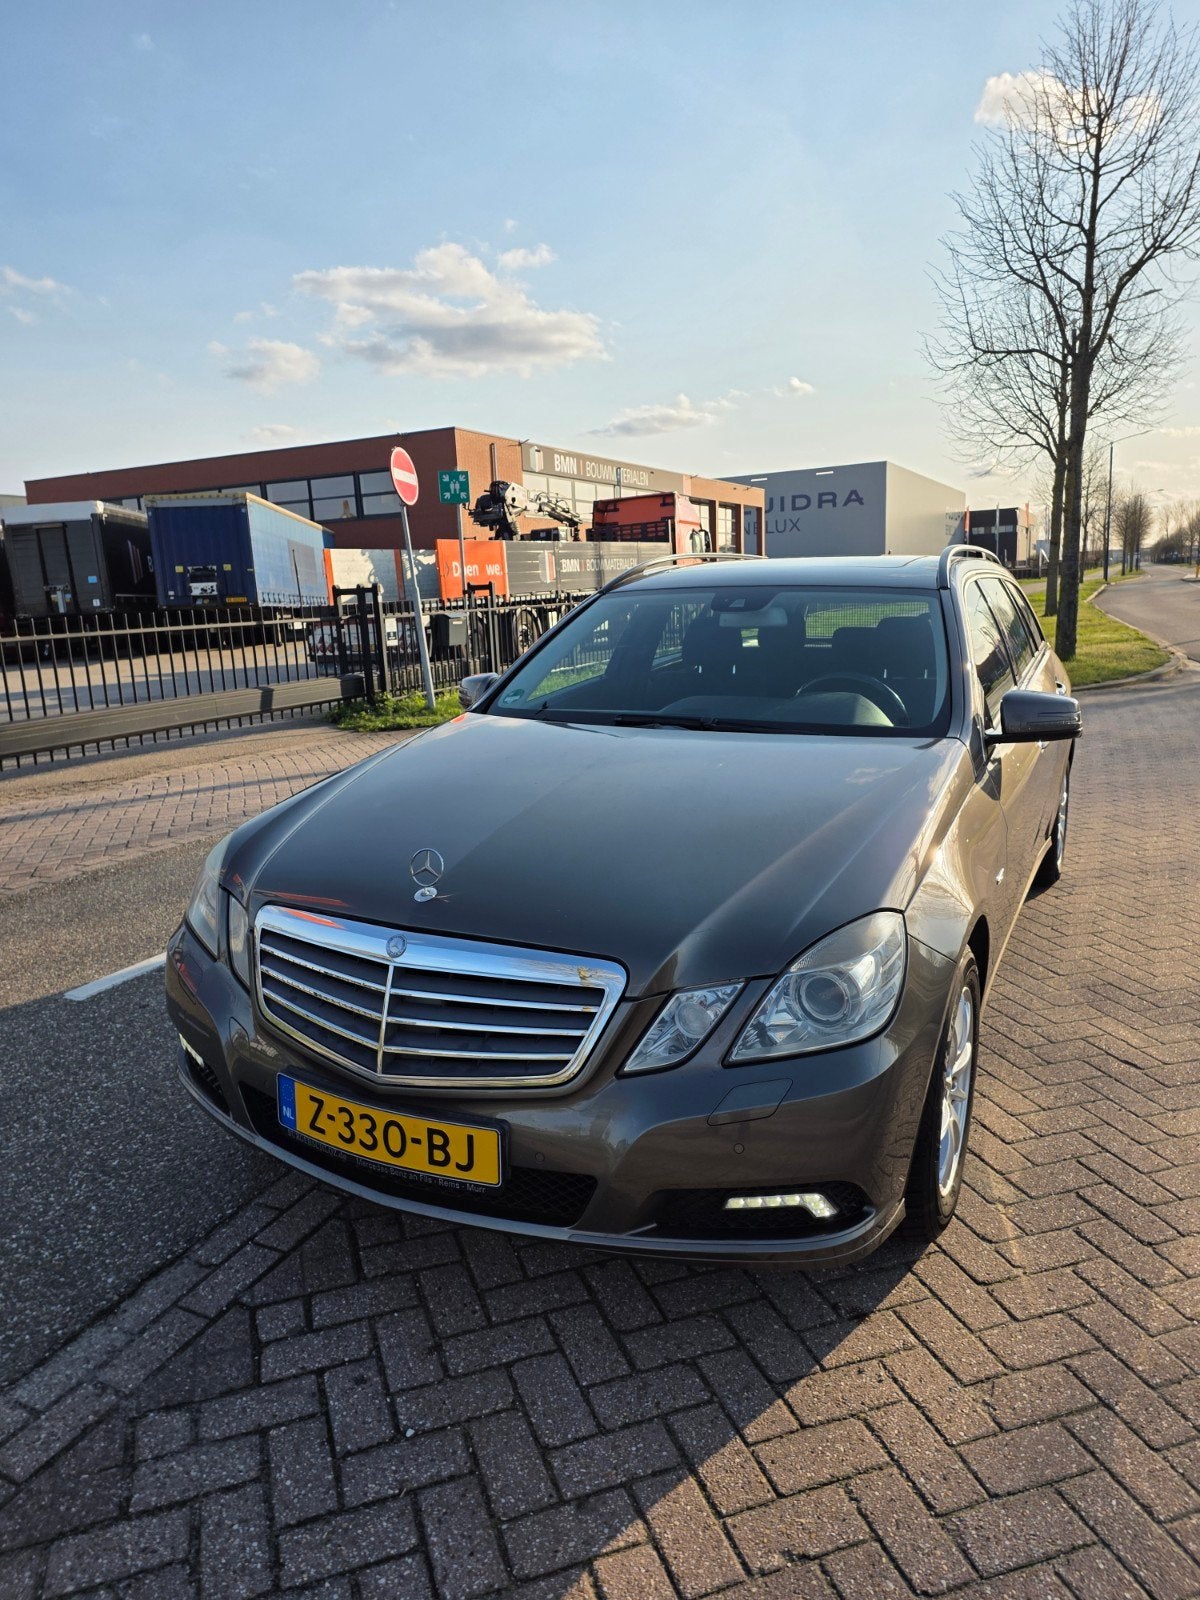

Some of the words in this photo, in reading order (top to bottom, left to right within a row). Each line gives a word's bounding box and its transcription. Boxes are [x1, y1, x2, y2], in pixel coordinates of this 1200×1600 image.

[554, 454, 578, 475] BMN
[586, 461, 649, 486] BOUWMTERIALEN
[560, 558, 580, 573] BMN
[282, 1106, 294, 1120] NL
[308, 1094, 475, 1172] Z-330-BJ
